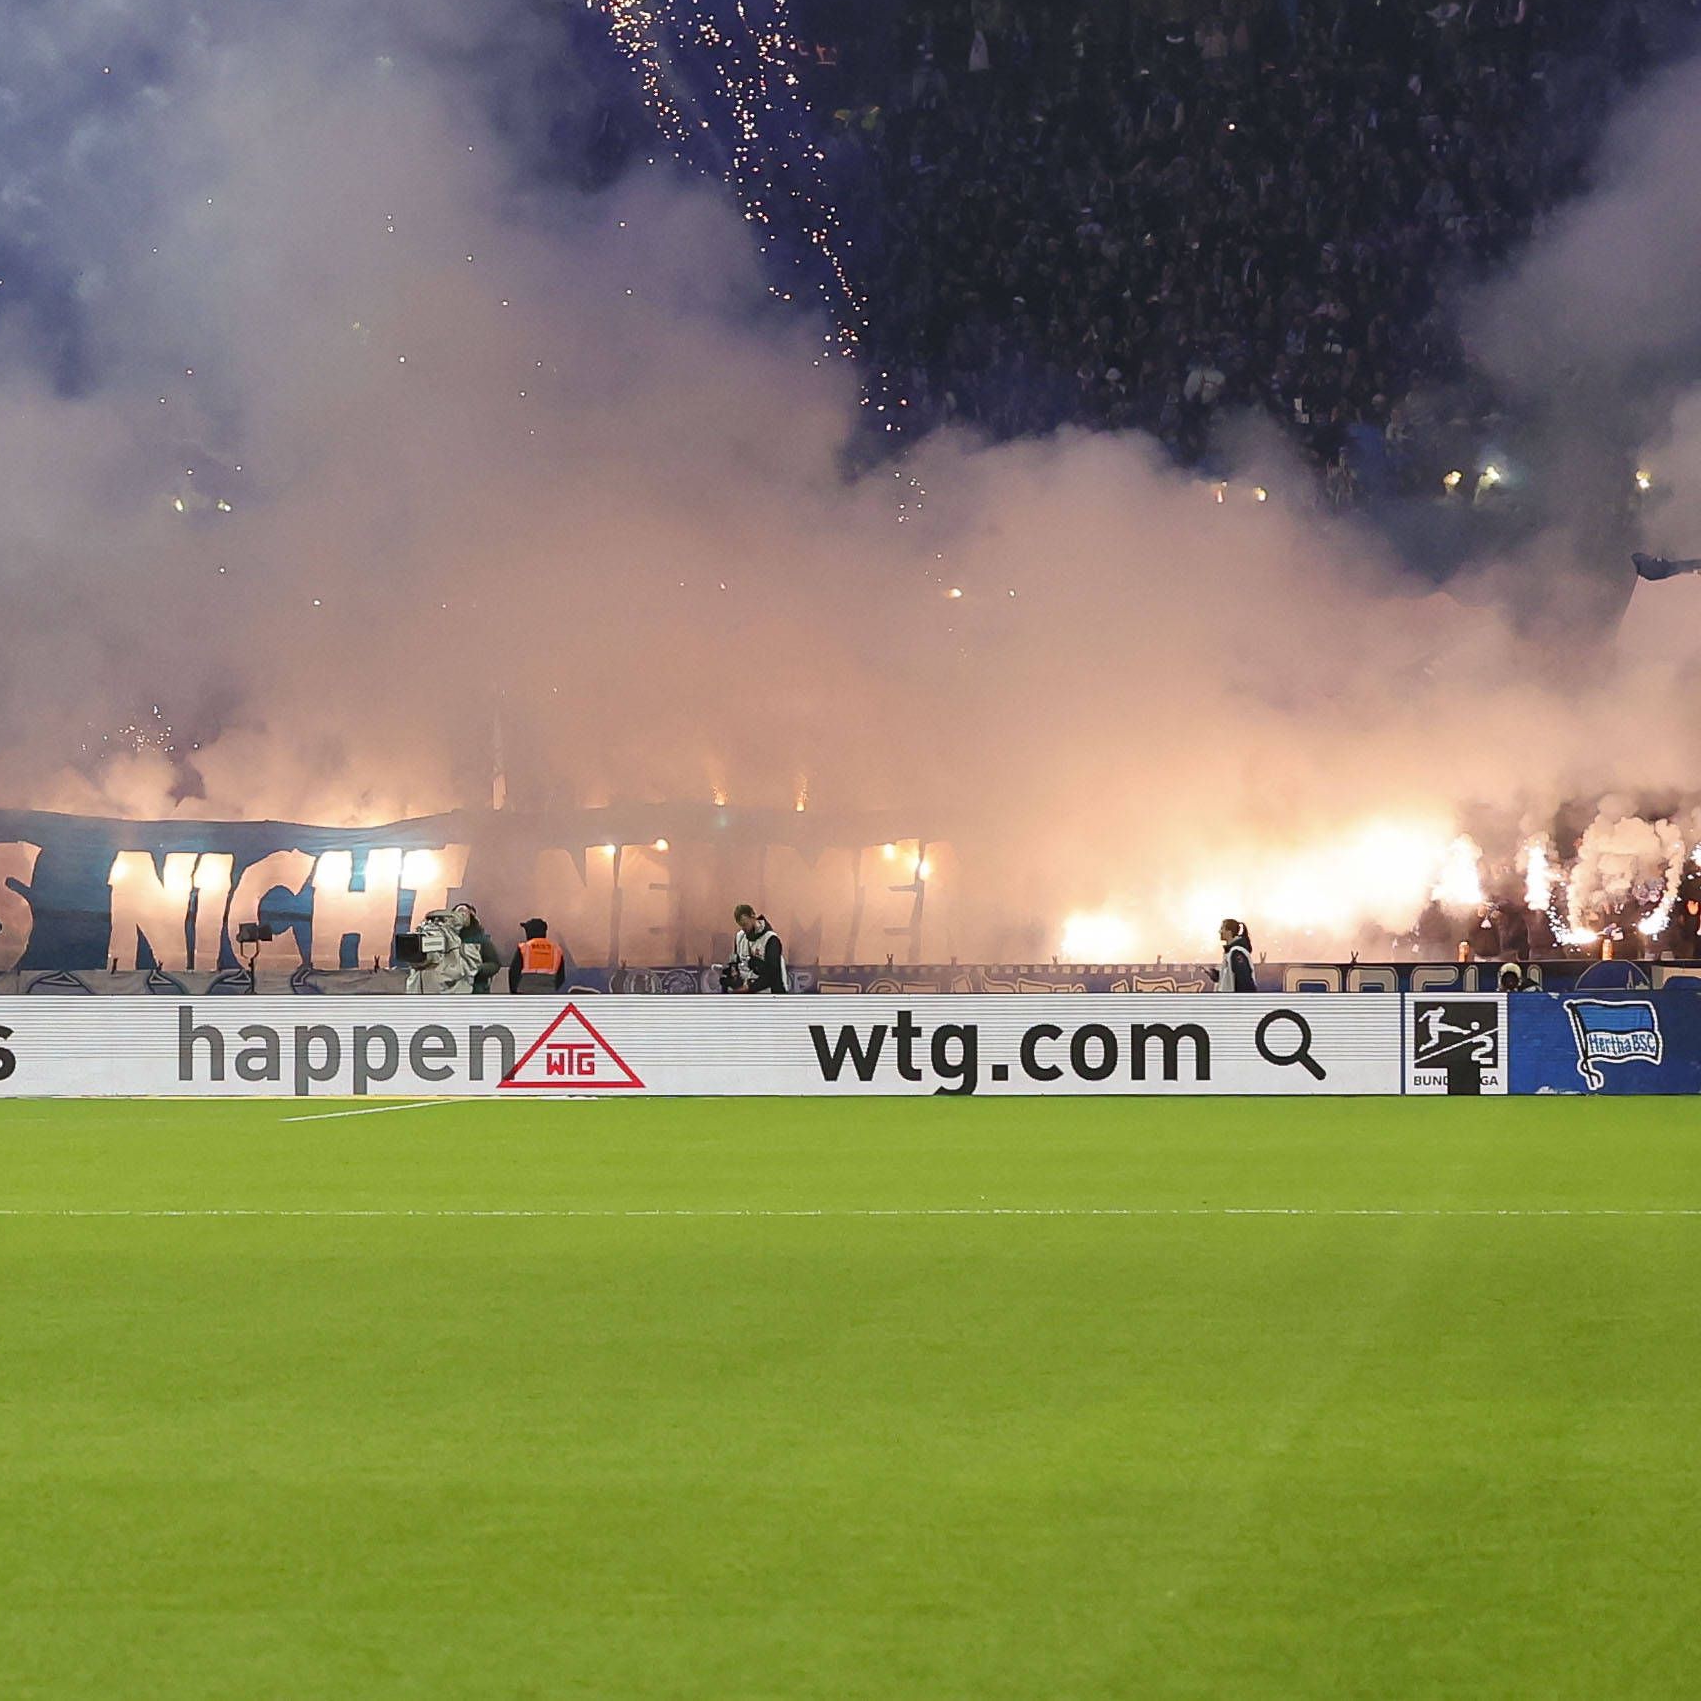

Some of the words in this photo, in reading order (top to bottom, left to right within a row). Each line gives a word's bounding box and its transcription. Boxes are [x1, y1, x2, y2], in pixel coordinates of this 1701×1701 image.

[107, 843, 471, 971] NICHT
[178, 1005, 516, 1095] happen
[546, 1045, 595, 1076] WTG
[809, 1009, 1211, 1095] wtg.com
[1588, 1032, 1632, 1055] Hertha
[1633, 1031, 1655, 1054] BSC
[1413, 1075, 1498, 1087] BUNDGA
